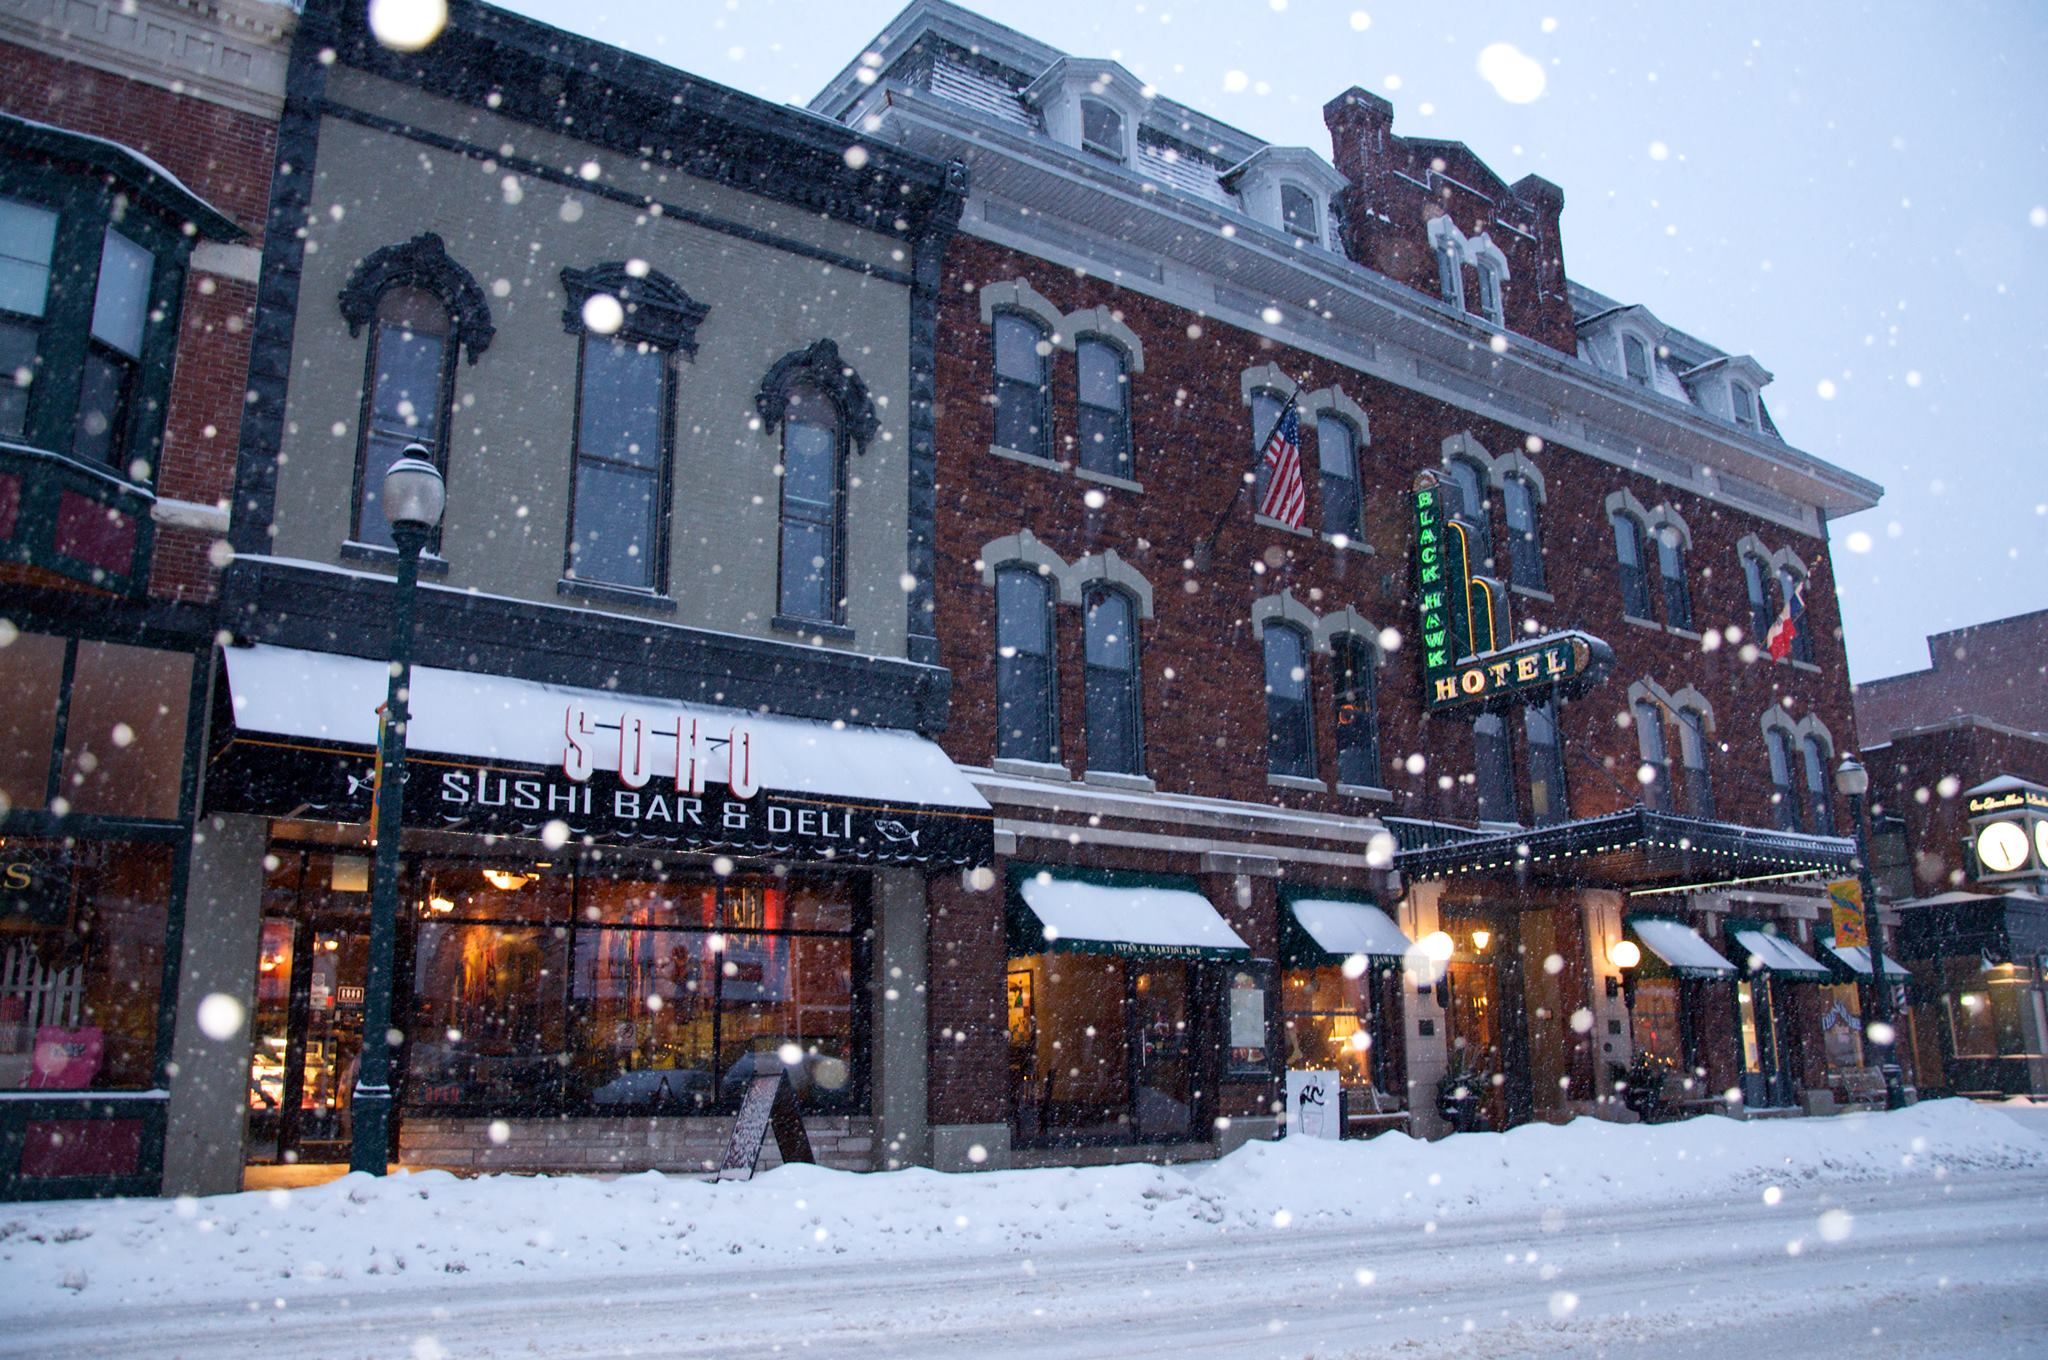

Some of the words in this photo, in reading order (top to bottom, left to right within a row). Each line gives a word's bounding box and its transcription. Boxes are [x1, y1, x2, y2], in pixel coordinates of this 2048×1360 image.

[1418, 492, 1440, 583] BLACK
[1425, 592, 1447, 668] HAWK
[1434, 649, 1567, 701] HOTEL
[562, 703, 760, 800] SOHO
[441, 772, 592, 815] SUSHI
[614, 790, 703, 825] BAR
[722, 802, 750, 830] &
[767, 806, 851, 839] DELI
